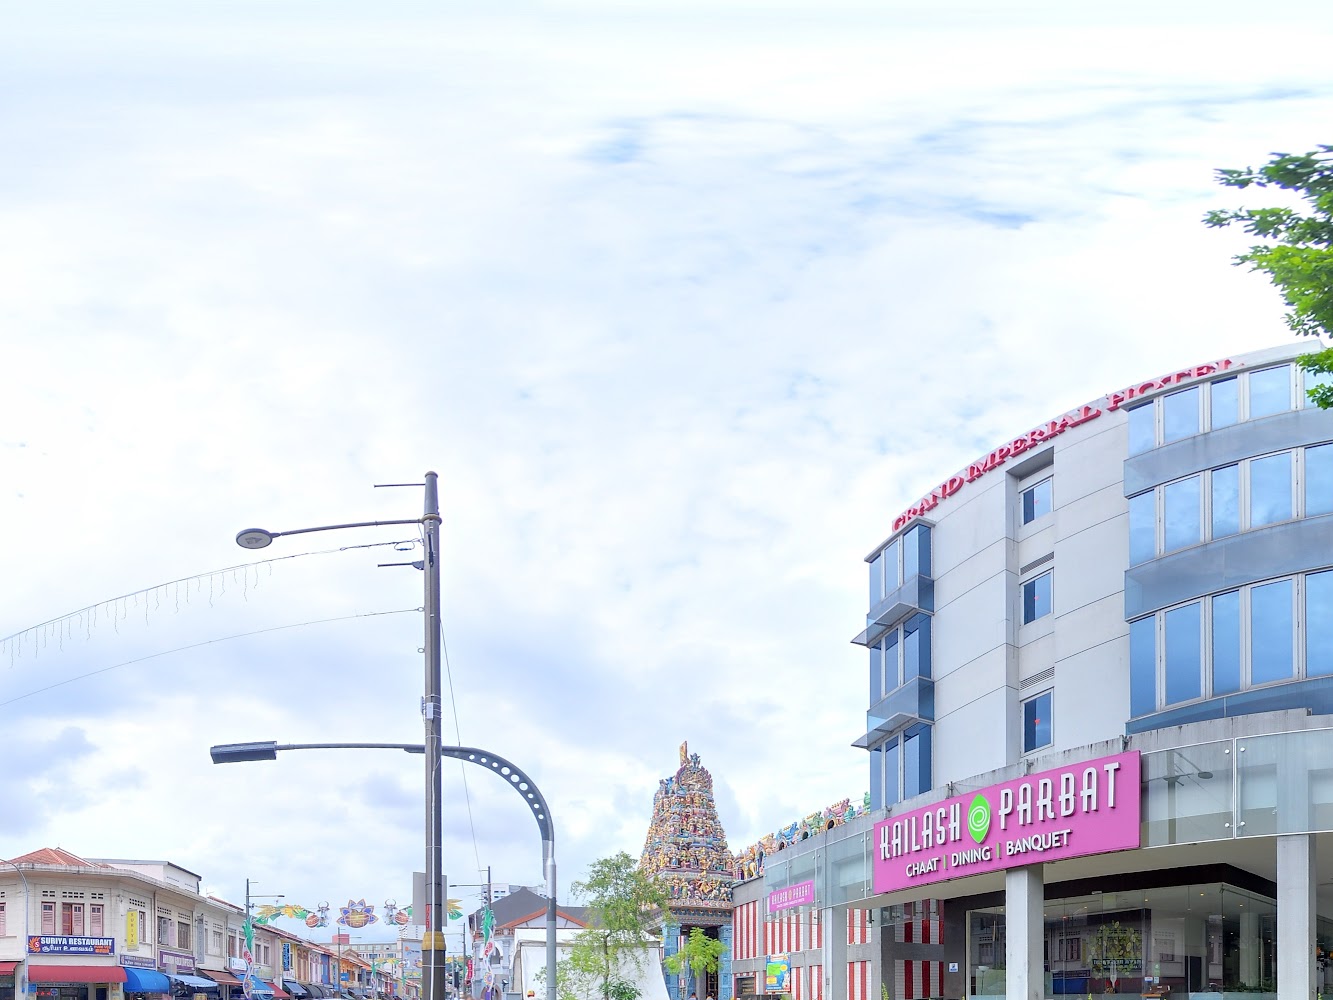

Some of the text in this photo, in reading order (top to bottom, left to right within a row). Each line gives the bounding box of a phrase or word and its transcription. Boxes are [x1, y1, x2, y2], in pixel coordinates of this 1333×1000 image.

[892, 476, 964, 533] GRAND
[965, 405, 1101, 484] IMPERIAL
[880, 762, 1121, 860] KAILASH PARBAT
[905, 829, 1073, 877] CHAAT DINING BANQUET
[40, 937, 113, 946] SURIYA RESTAURANT
